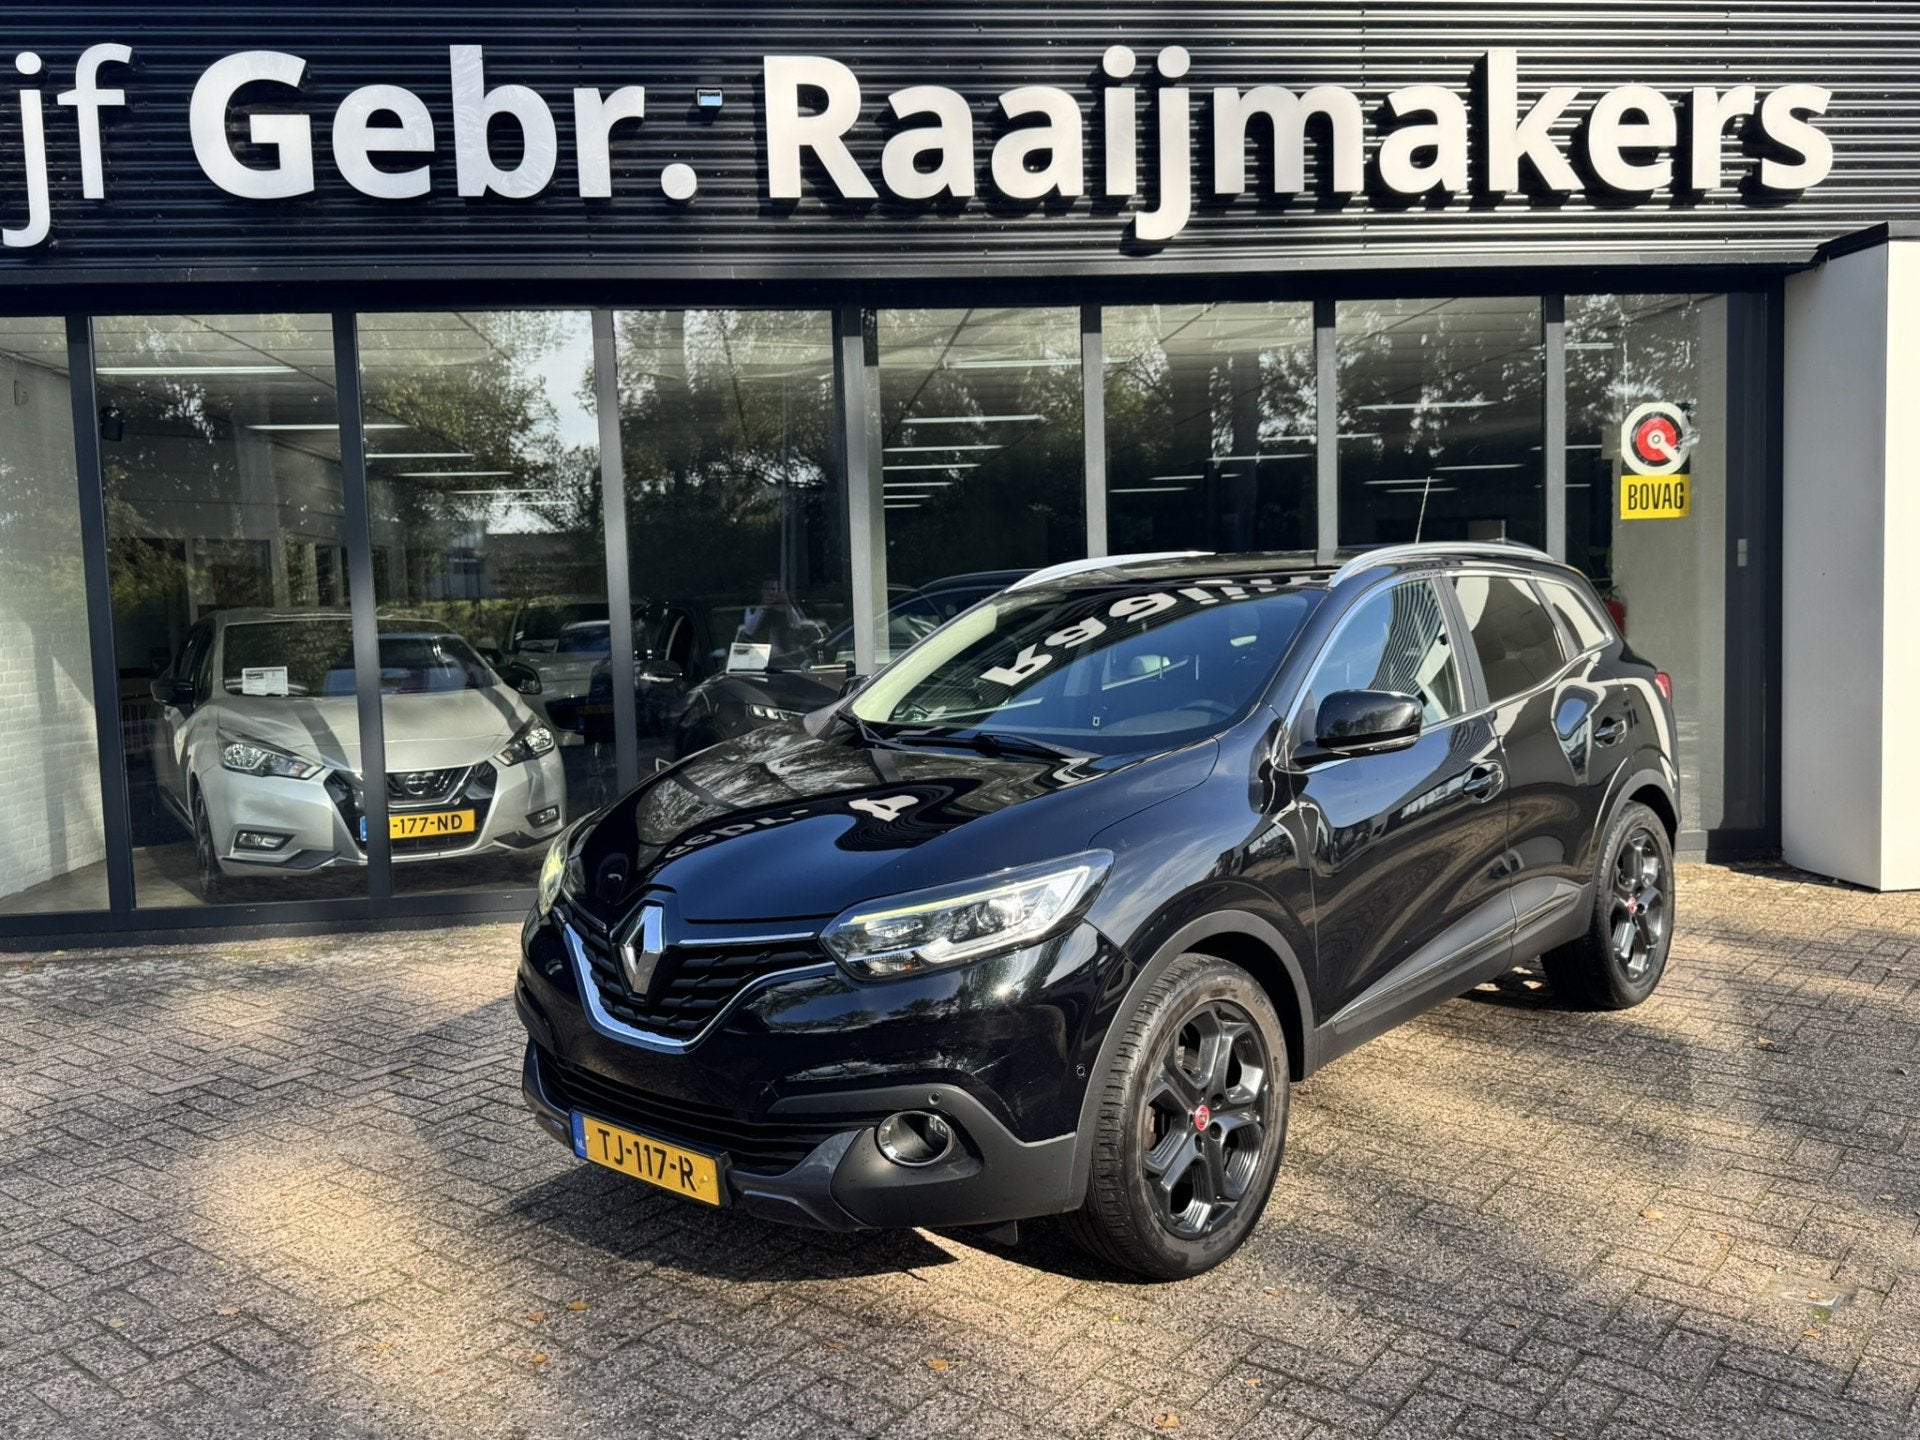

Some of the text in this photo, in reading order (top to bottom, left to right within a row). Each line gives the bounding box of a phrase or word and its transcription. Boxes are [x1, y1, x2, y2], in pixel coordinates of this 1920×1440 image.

[189, 45, 698, 200] Gebr.
[763, 45, 1834, 241] Raaijmakers
[1627, 482, 1685, 510] BOVAG
[393, 814, 463, 834] -177-ND
[597, 1127, 698, 1192] TJ-117-R
